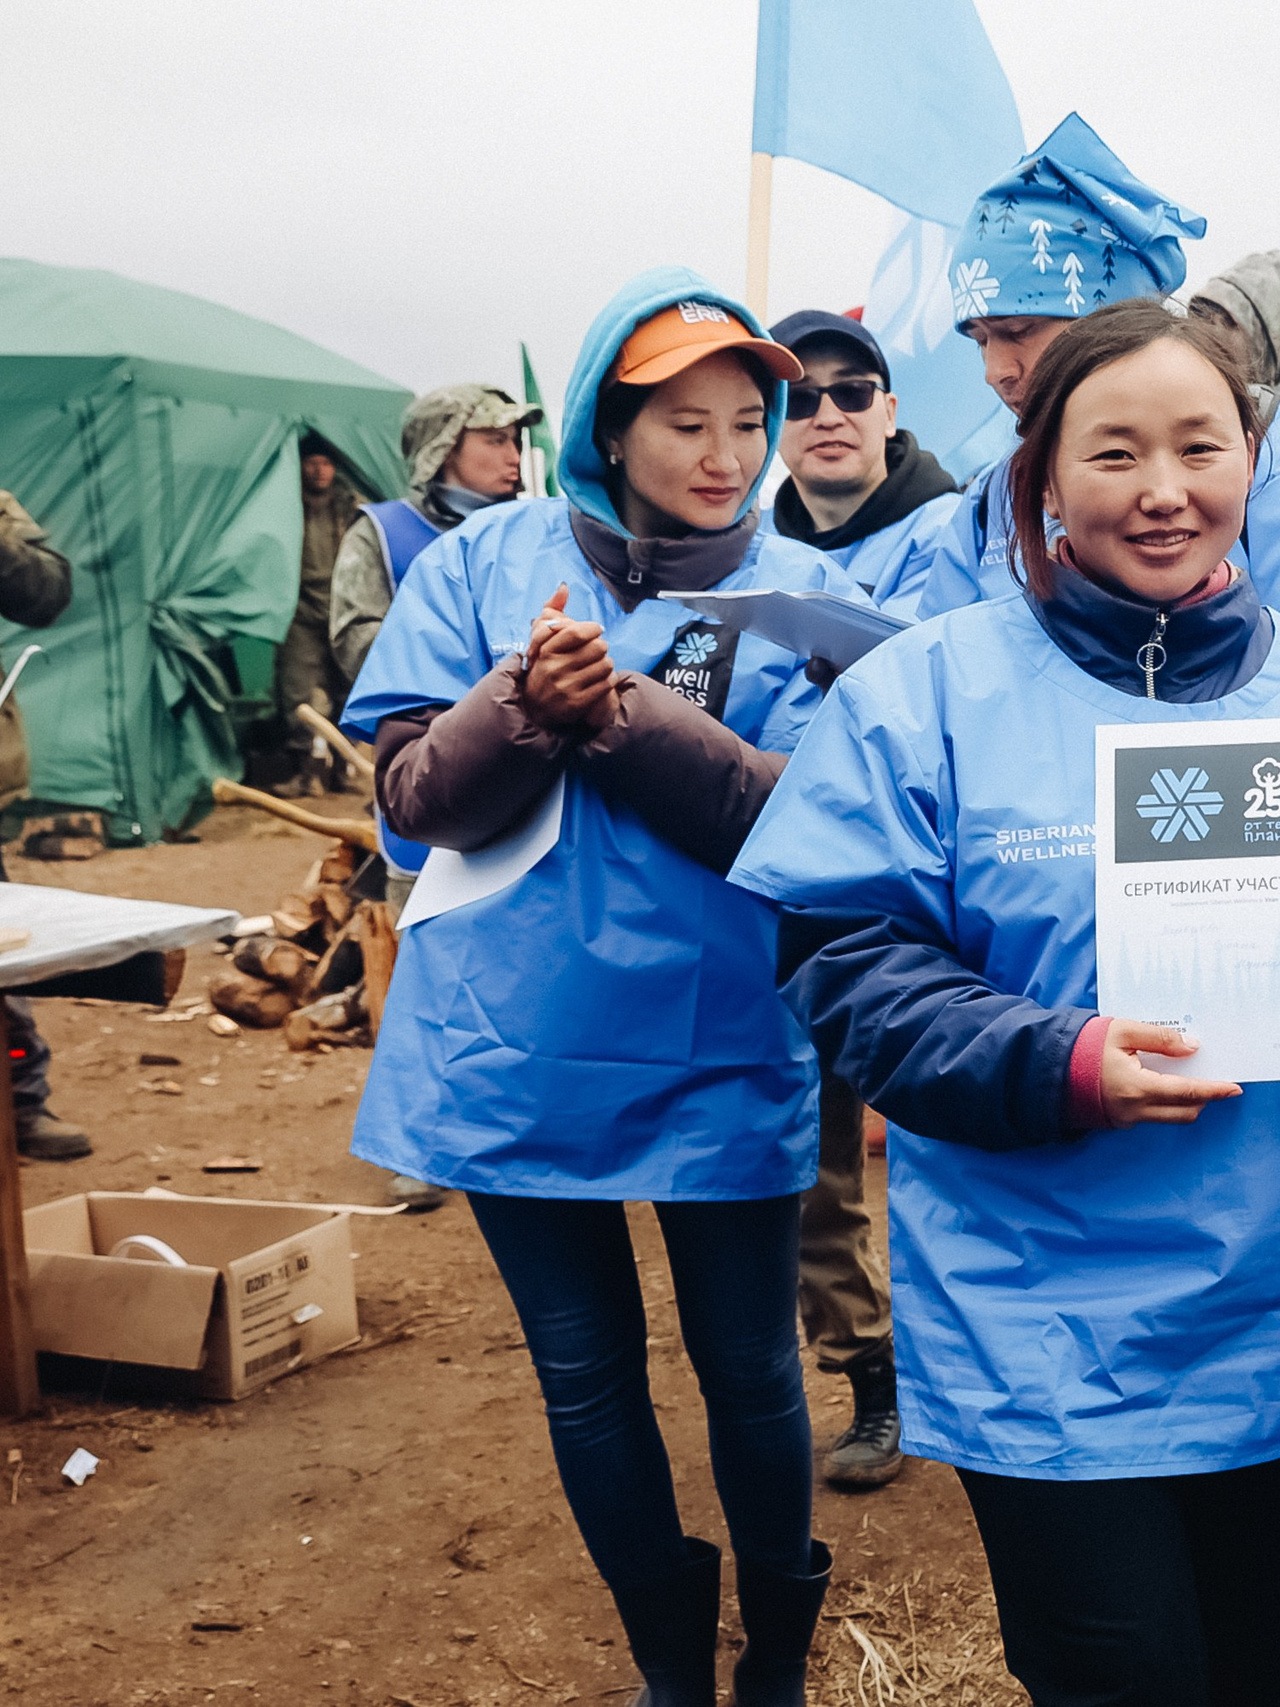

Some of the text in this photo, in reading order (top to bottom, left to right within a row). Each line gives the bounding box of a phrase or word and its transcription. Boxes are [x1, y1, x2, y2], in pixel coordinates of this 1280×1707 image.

[681, 308, 730, 324] ERA
[665, 669, 710, 691] Well
[997, 843, 1096, 864] WELLNE
[1124, 878, 1231, 897] СЕРТИФИКАТ
